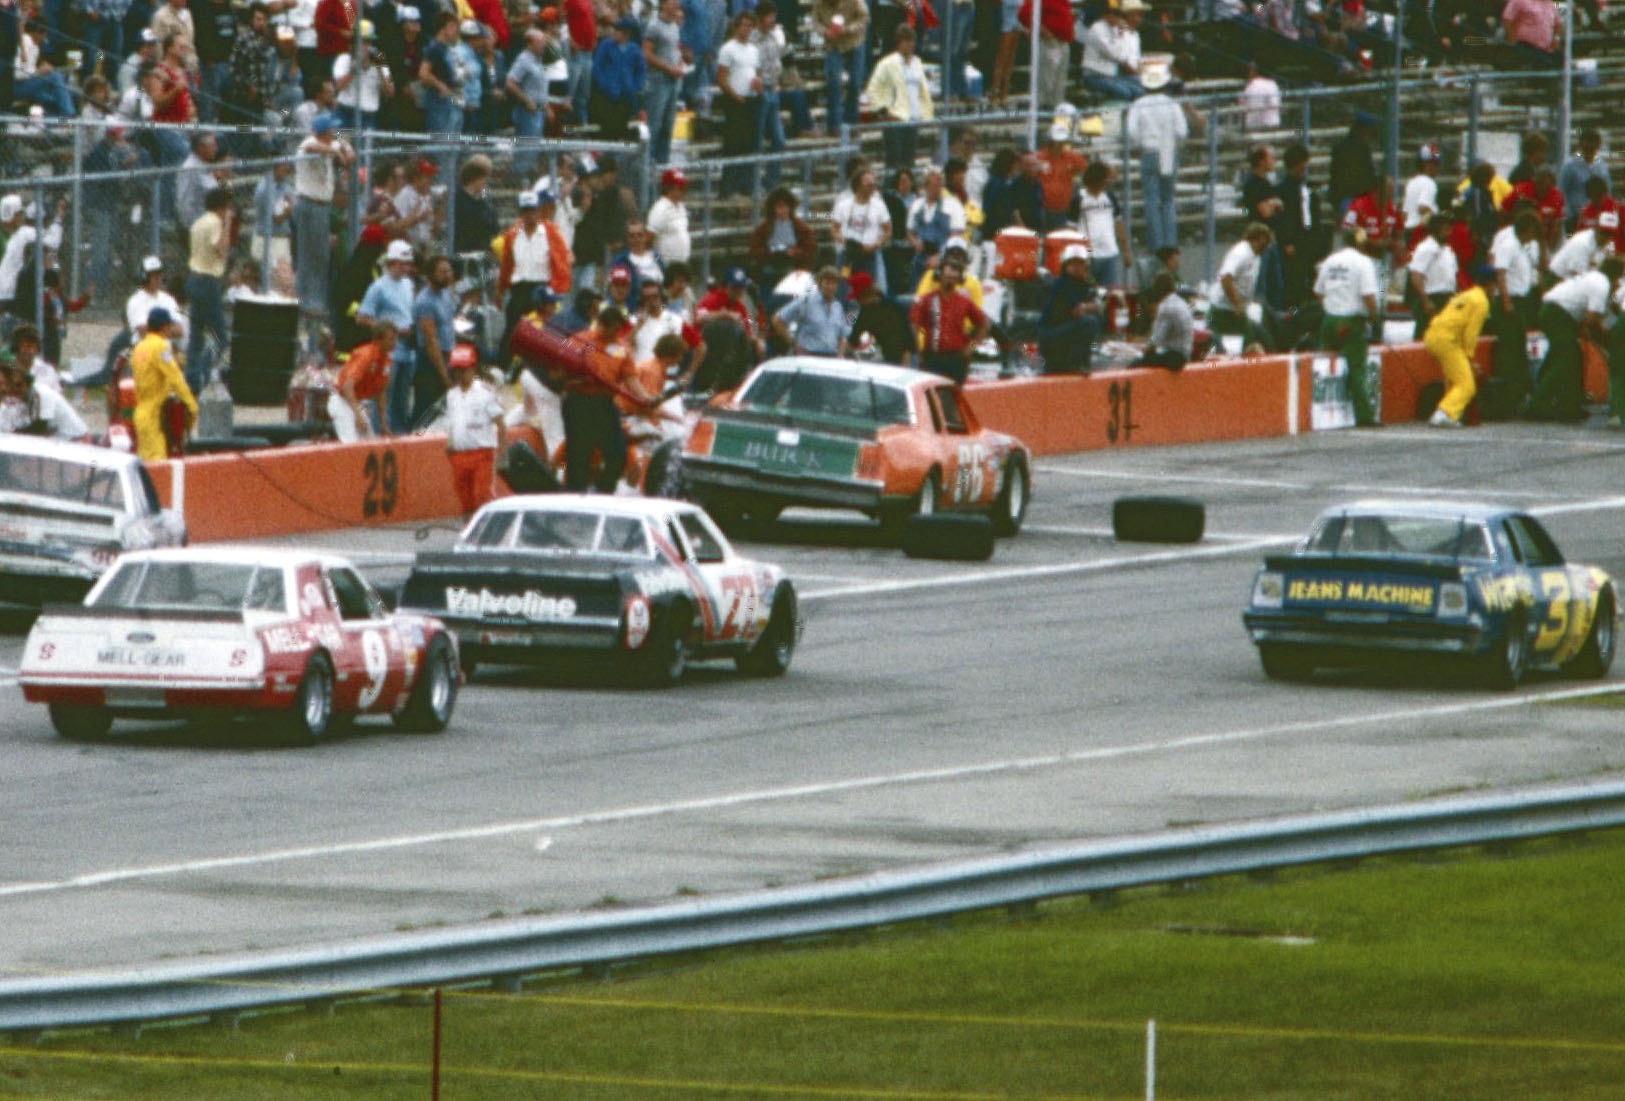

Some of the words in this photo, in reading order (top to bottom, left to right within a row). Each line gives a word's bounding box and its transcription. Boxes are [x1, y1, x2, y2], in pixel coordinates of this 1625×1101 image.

[1107, 380, 1138, 443] 31
[363, 450, 399, 518] 29
[445, 586, 577, 618] Valvoline
[1288, 579, 1342, 601] JEANS
[1346, 581, 1435, 608] MACHINE
[1534, 571, 1569, 651] 3
[358, 629, 393, 709] 9
